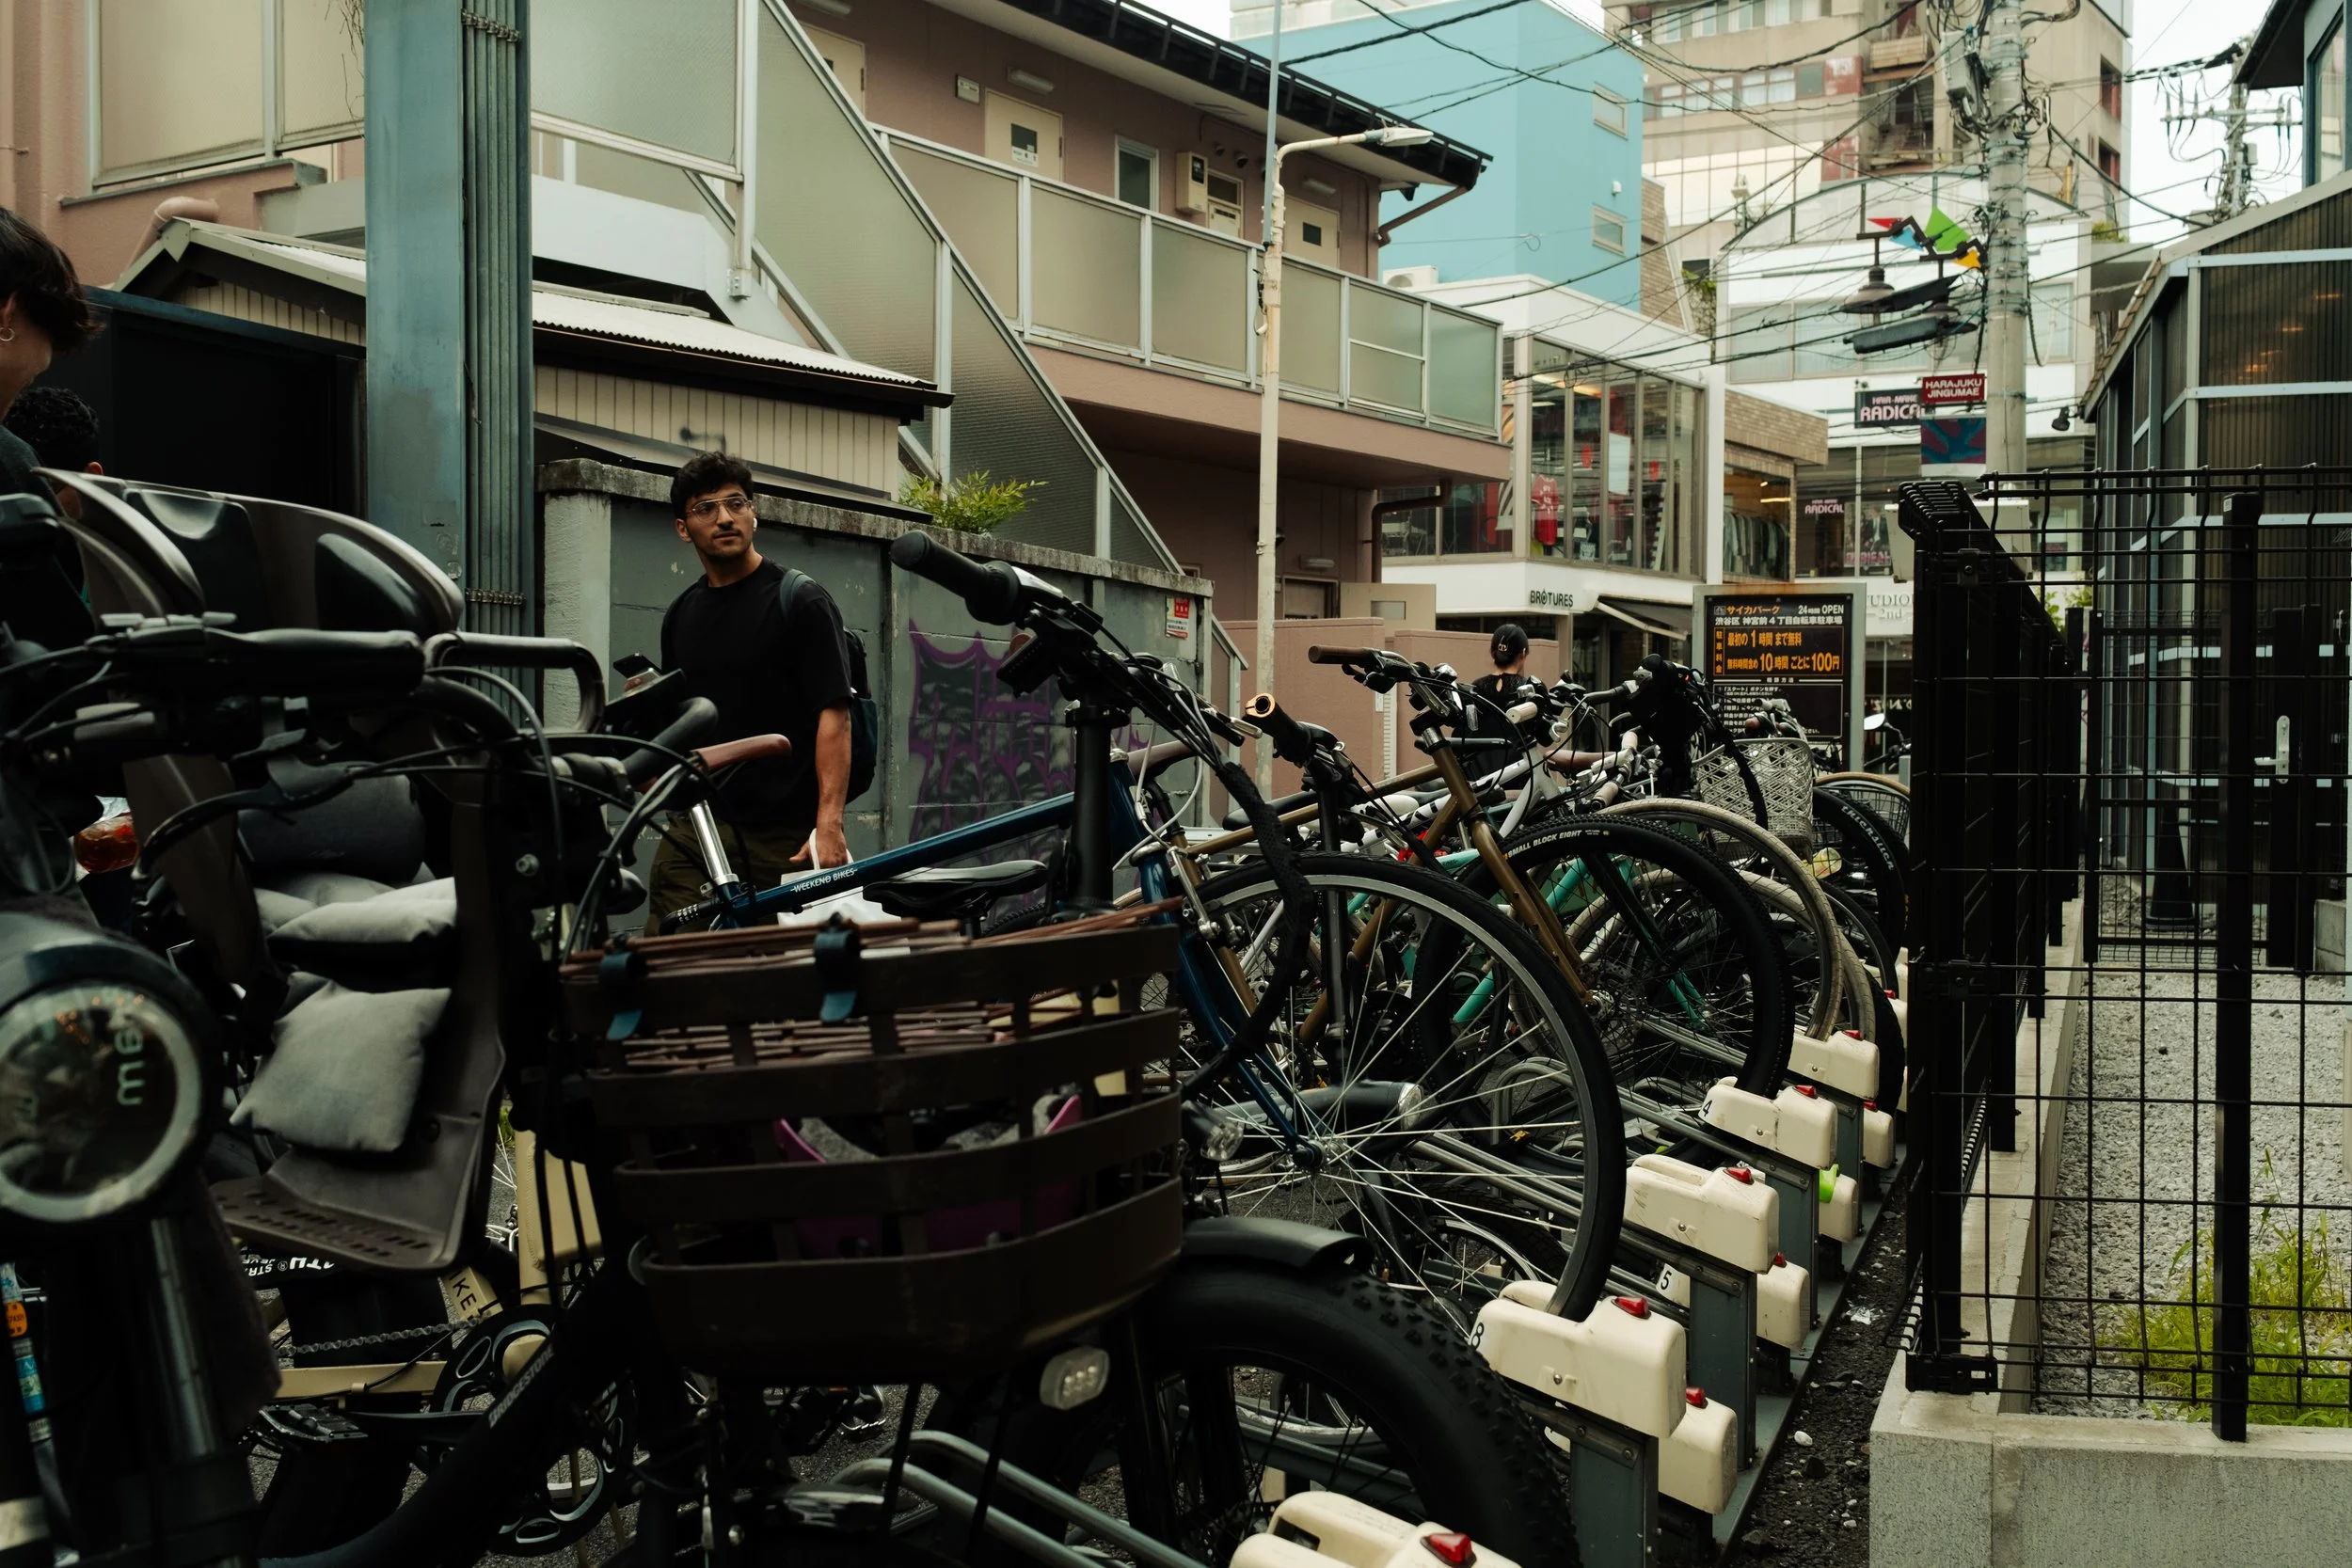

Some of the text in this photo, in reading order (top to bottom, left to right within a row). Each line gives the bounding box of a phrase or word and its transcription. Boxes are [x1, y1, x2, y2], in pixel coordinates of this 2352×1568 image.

[1925, 378, 1982, 389] HARAJUKU
[1928, 388, 1979, 399] JINGUMAE
[1804, 503, 1845, 515] RADICAL
[1821, 604, 1844, 614] OPEN
[1867, 594, 1910, 608] UDIO
[1508, 843, 1531, 858] SMALL
[1534, 833, 1558, 847] BLOCK
[1559, 830, 1582, 839] EIGHT
[793, 868, 855, 893] WEEKEND BIKES
[1702, 1100, 1713, 1117] 4
[1661, 1271, 1672, 1291] 5
[1471, 1322, 1485, 1352] 8
[487, 1342, 556, 1429] BRIDGESTONE
